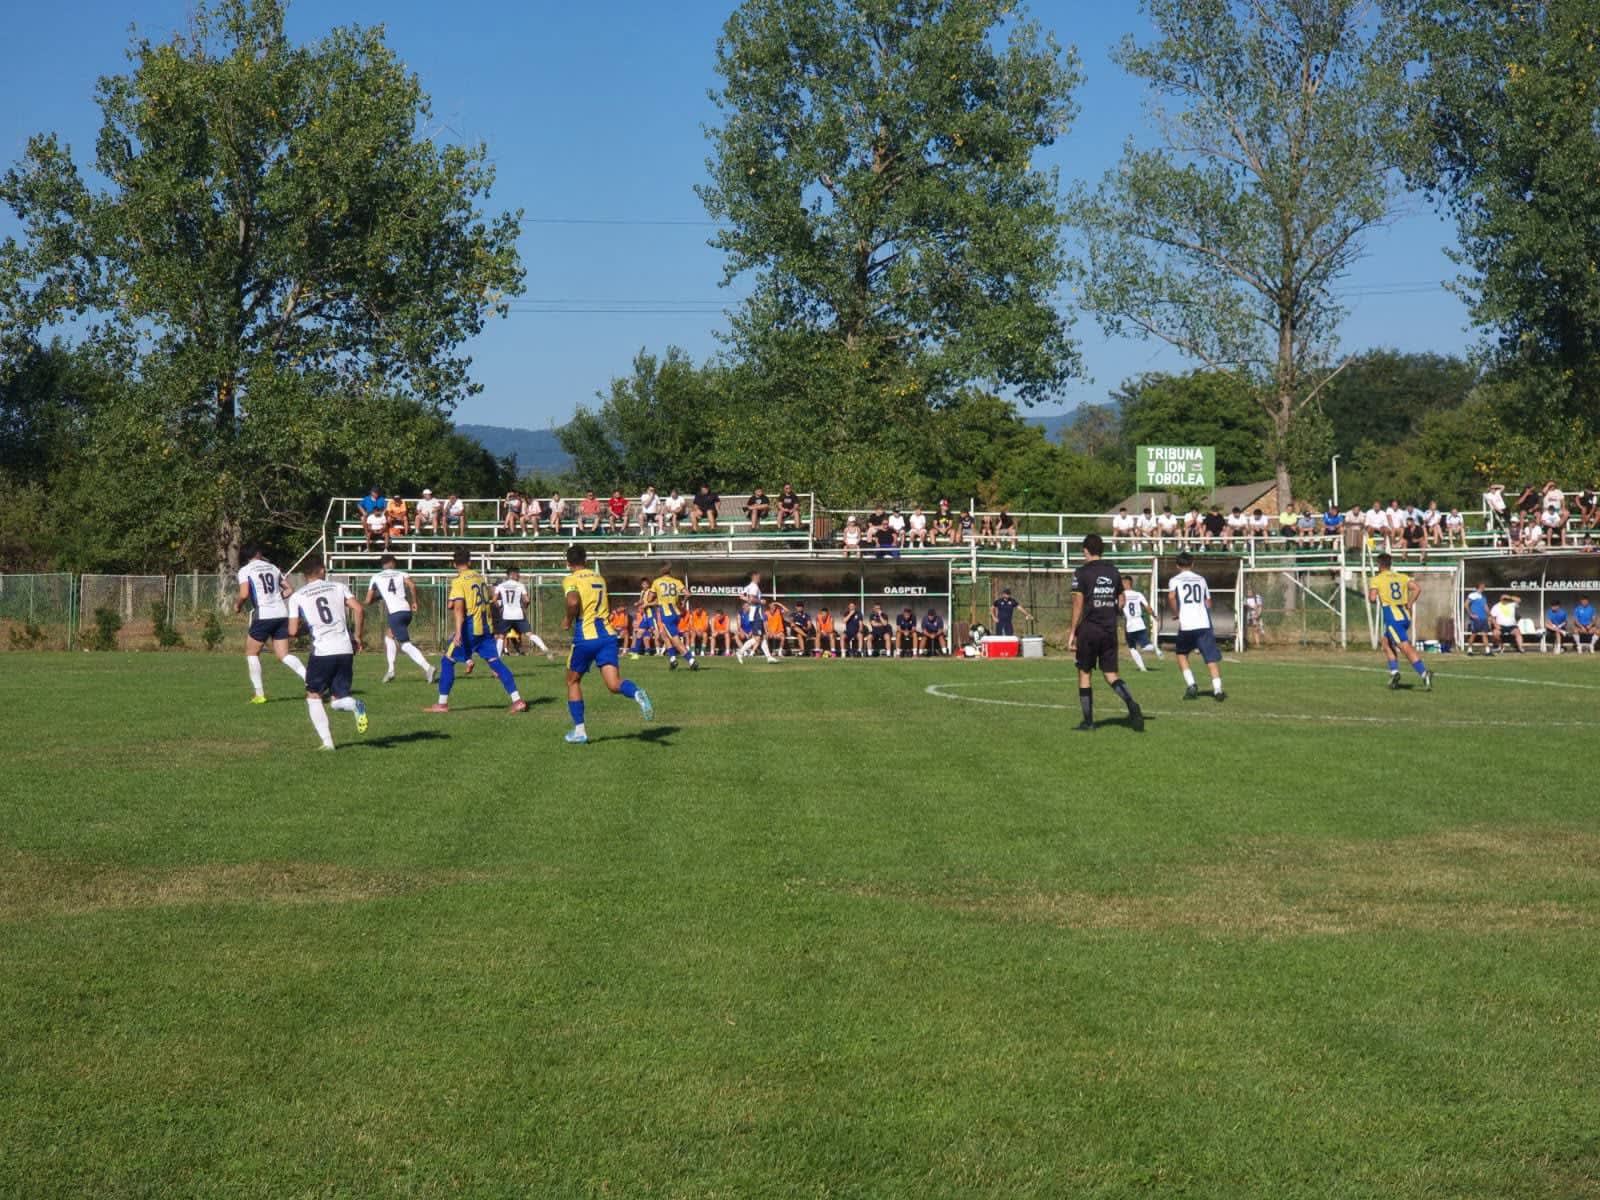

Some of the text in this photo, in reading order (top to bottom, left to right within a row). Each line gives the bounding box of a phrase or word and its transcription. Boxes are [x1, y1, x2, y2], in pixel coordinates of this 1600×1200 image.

[1147, 447, 1204, 460] TRIBUNA
[1164, 460, 1186, 473] ION
[1147, 472, 1205, 486] TOBOLEA
[258, 572, 276, 594] 19
[387, 578, 397, 594] 4
[659, 582, 677, 597] 28
[690, 585, 746, 594] CARANSEB
[1545, 580, 1600, 590] CARANSEB
[505, 589, 516, 604] 17
[591, 583, 603, 612] 7
[1183, 583, 1202, 604] 20
[1390, 582, 1402, 600] 8
[315, 596, 334, 625] 6
[1128, 602, 1136, 617] 8
